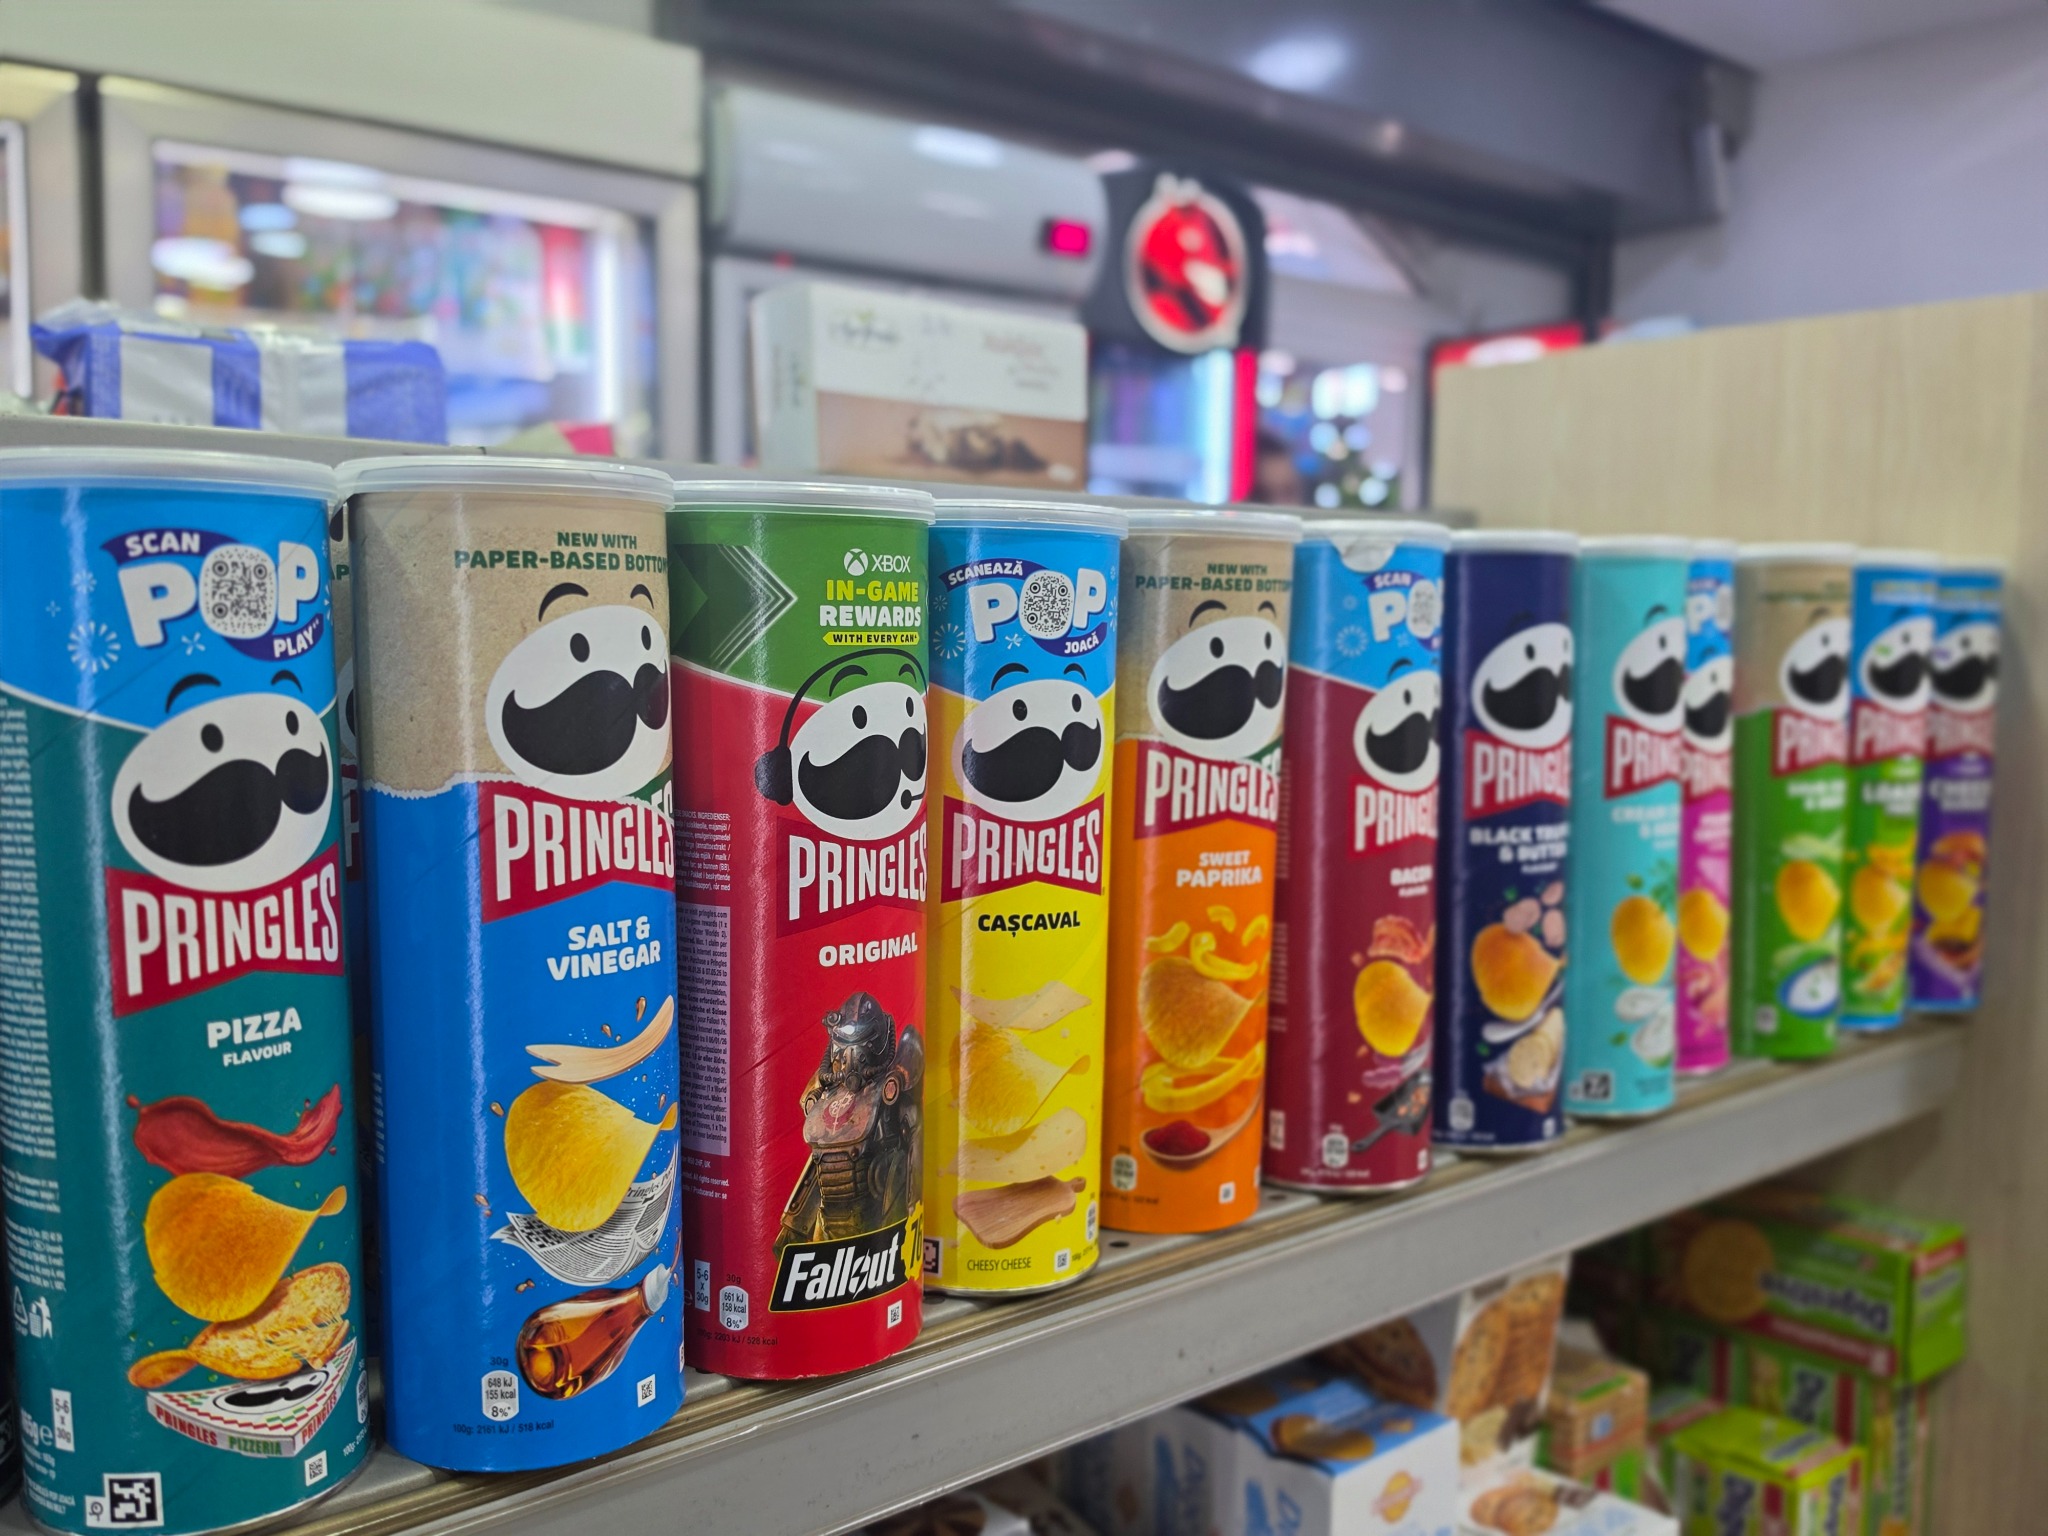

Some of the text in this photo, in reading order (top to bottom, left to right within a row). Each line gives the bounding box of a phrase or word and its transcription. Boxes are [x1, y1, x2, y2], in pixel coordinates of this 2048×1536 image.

[125, 532, 200, 558] SCAN
[557, 531, 637, 550] NEW WITH
[454, 550, 620, 570] PAPER-BASED
[871, 554, 911, 573] XBOX
[1207, 563, 1267, 575] NEW WITH
[948, 561, 1023, 586] SCANEAZĂ
[1135, 576, 1252, 592] PAPER-BASED
[1374, 573, 1411, 588] SCAN
[826, 579, 919, 602] IN-GAME
[820, 605, 922, 627] REWARDS
[833, 634, 863, 643] WITH
[866, 634, 898, 643] EVERY
[1064, 632, 1099, 654] JOACĂ
[494, 780, 675, 902] PRINGLES
[952, 809, 1100, 889] PRINGLES
[1198, 850, 1250, 867] SWEET
[789, 821, 927, 921] PRINGLES
[1176, 866, 1262, 888] PAPRIKA
[121, 862, 339, 997] PRINGLES
[568, 916, 650, 951] SALT &
[978, 910, 1080, 938] CAȘCAVAL
[547, 940, 661, 981] VINEGAR
[818, 932, 918, 967] ORIGINAL
[207, 1007, 302, 1048] PIZZA
[223, 1041, 292, 1067] FLAVOUR
[697, 1268, 708, 1281] 5-6
[783, 1231, 899, 1303] Fallout
[967, 1257, 1032, 1271] CHEESY CHEESE
[697, 1291, 709, 1305] 30g
[722, 1302, 746, 1313] 158 kcal
[724, 1292, 744, 1303] 661 kJ
[489, 1356, 509, 1367] 30g
[503, 1377, 513, 1387] kJ
[485, 1389, 516, 1400] 155 kcal
[302, 1390, 338, 1444] PRINGLES
[536, 1420, 555, 1431] kcal
[155, 1404, 283, 1455] PRINGLES PIZZERIA
